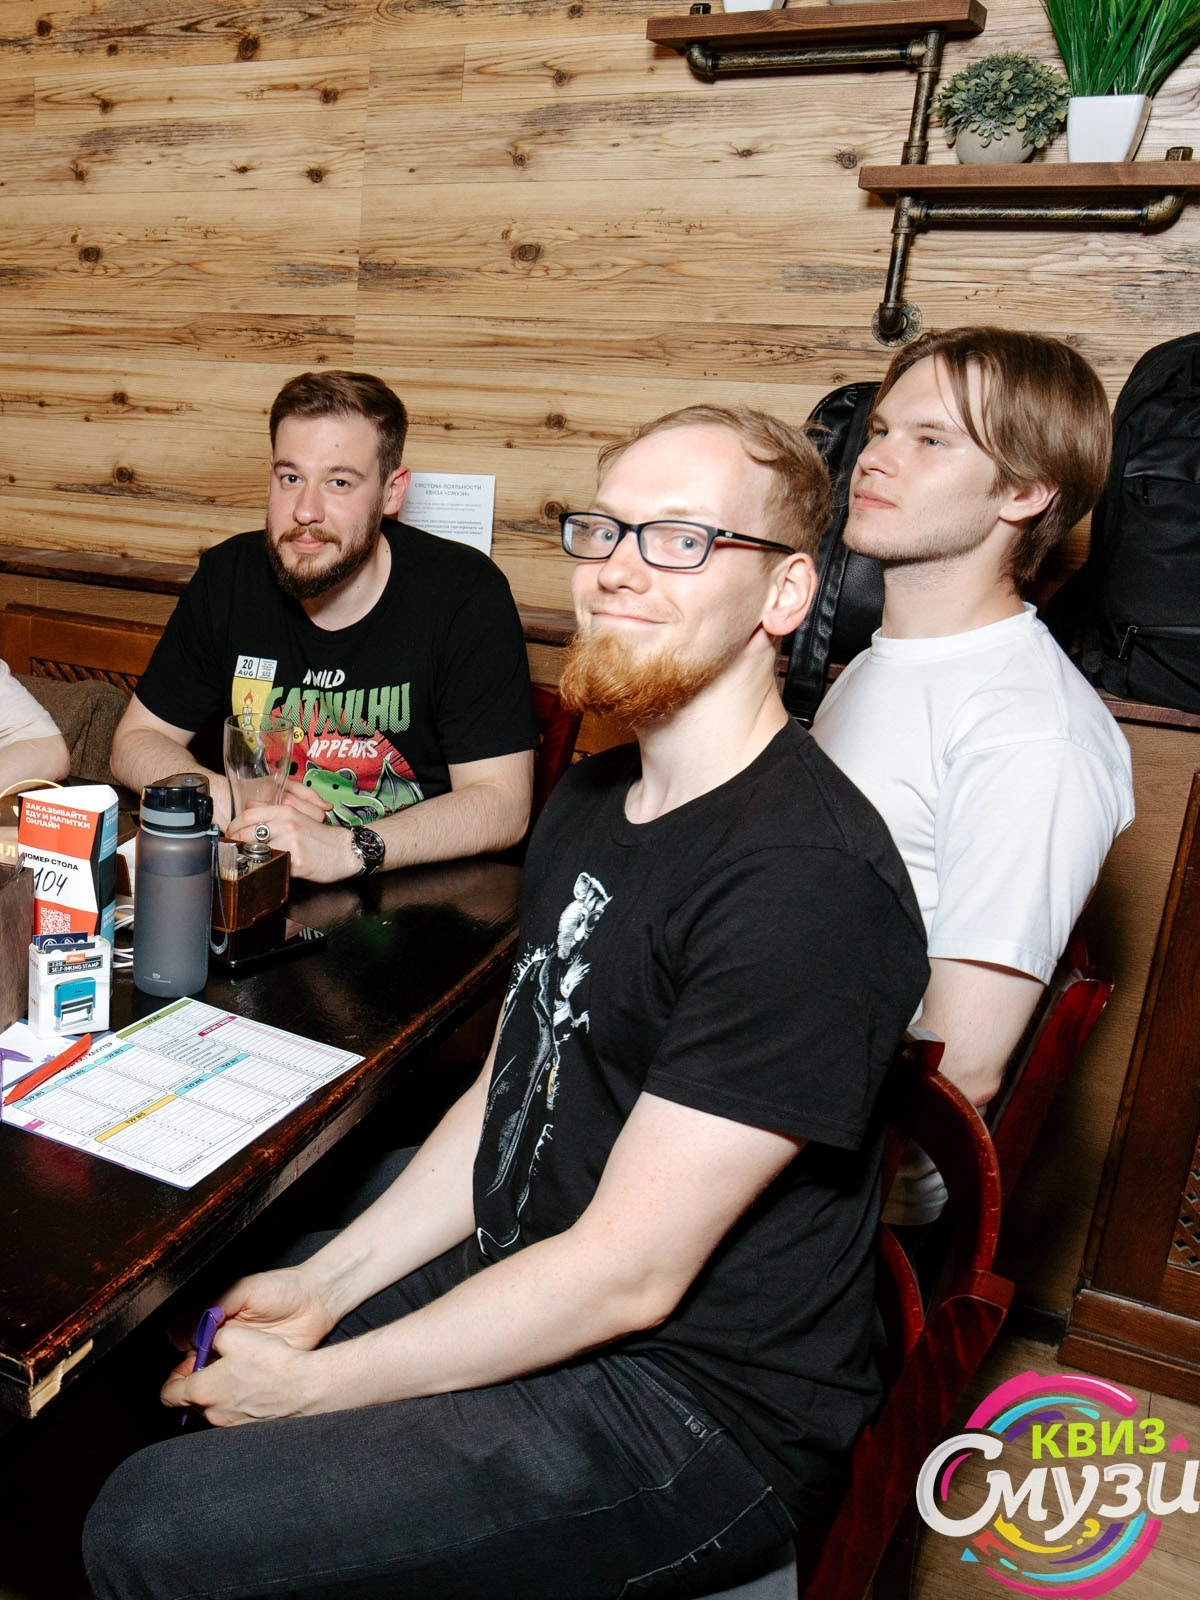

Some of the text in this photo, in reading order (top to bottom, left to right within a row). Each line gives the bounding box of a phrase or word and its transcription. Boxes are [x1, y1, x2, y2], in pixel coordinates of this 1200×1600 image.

[242, 658, 254, 670] 20
[238, 669, 254, 677] AUG
[311, 669, 346, 688] WILD
[306, 739, 379, 759] APPEARS
[25, 802, 88, 821] ЗАКАЗЫВАЙТЕ
[25, 809, 91, 829] ЕДУ И НАПИТКИ
[25, 816, 61, 829] ОНЛАЙН
[51, 859, 79, 871] СТОЛА
[34, 867, 68, 896] 104
[82, 960, 100, 970] STAMP
